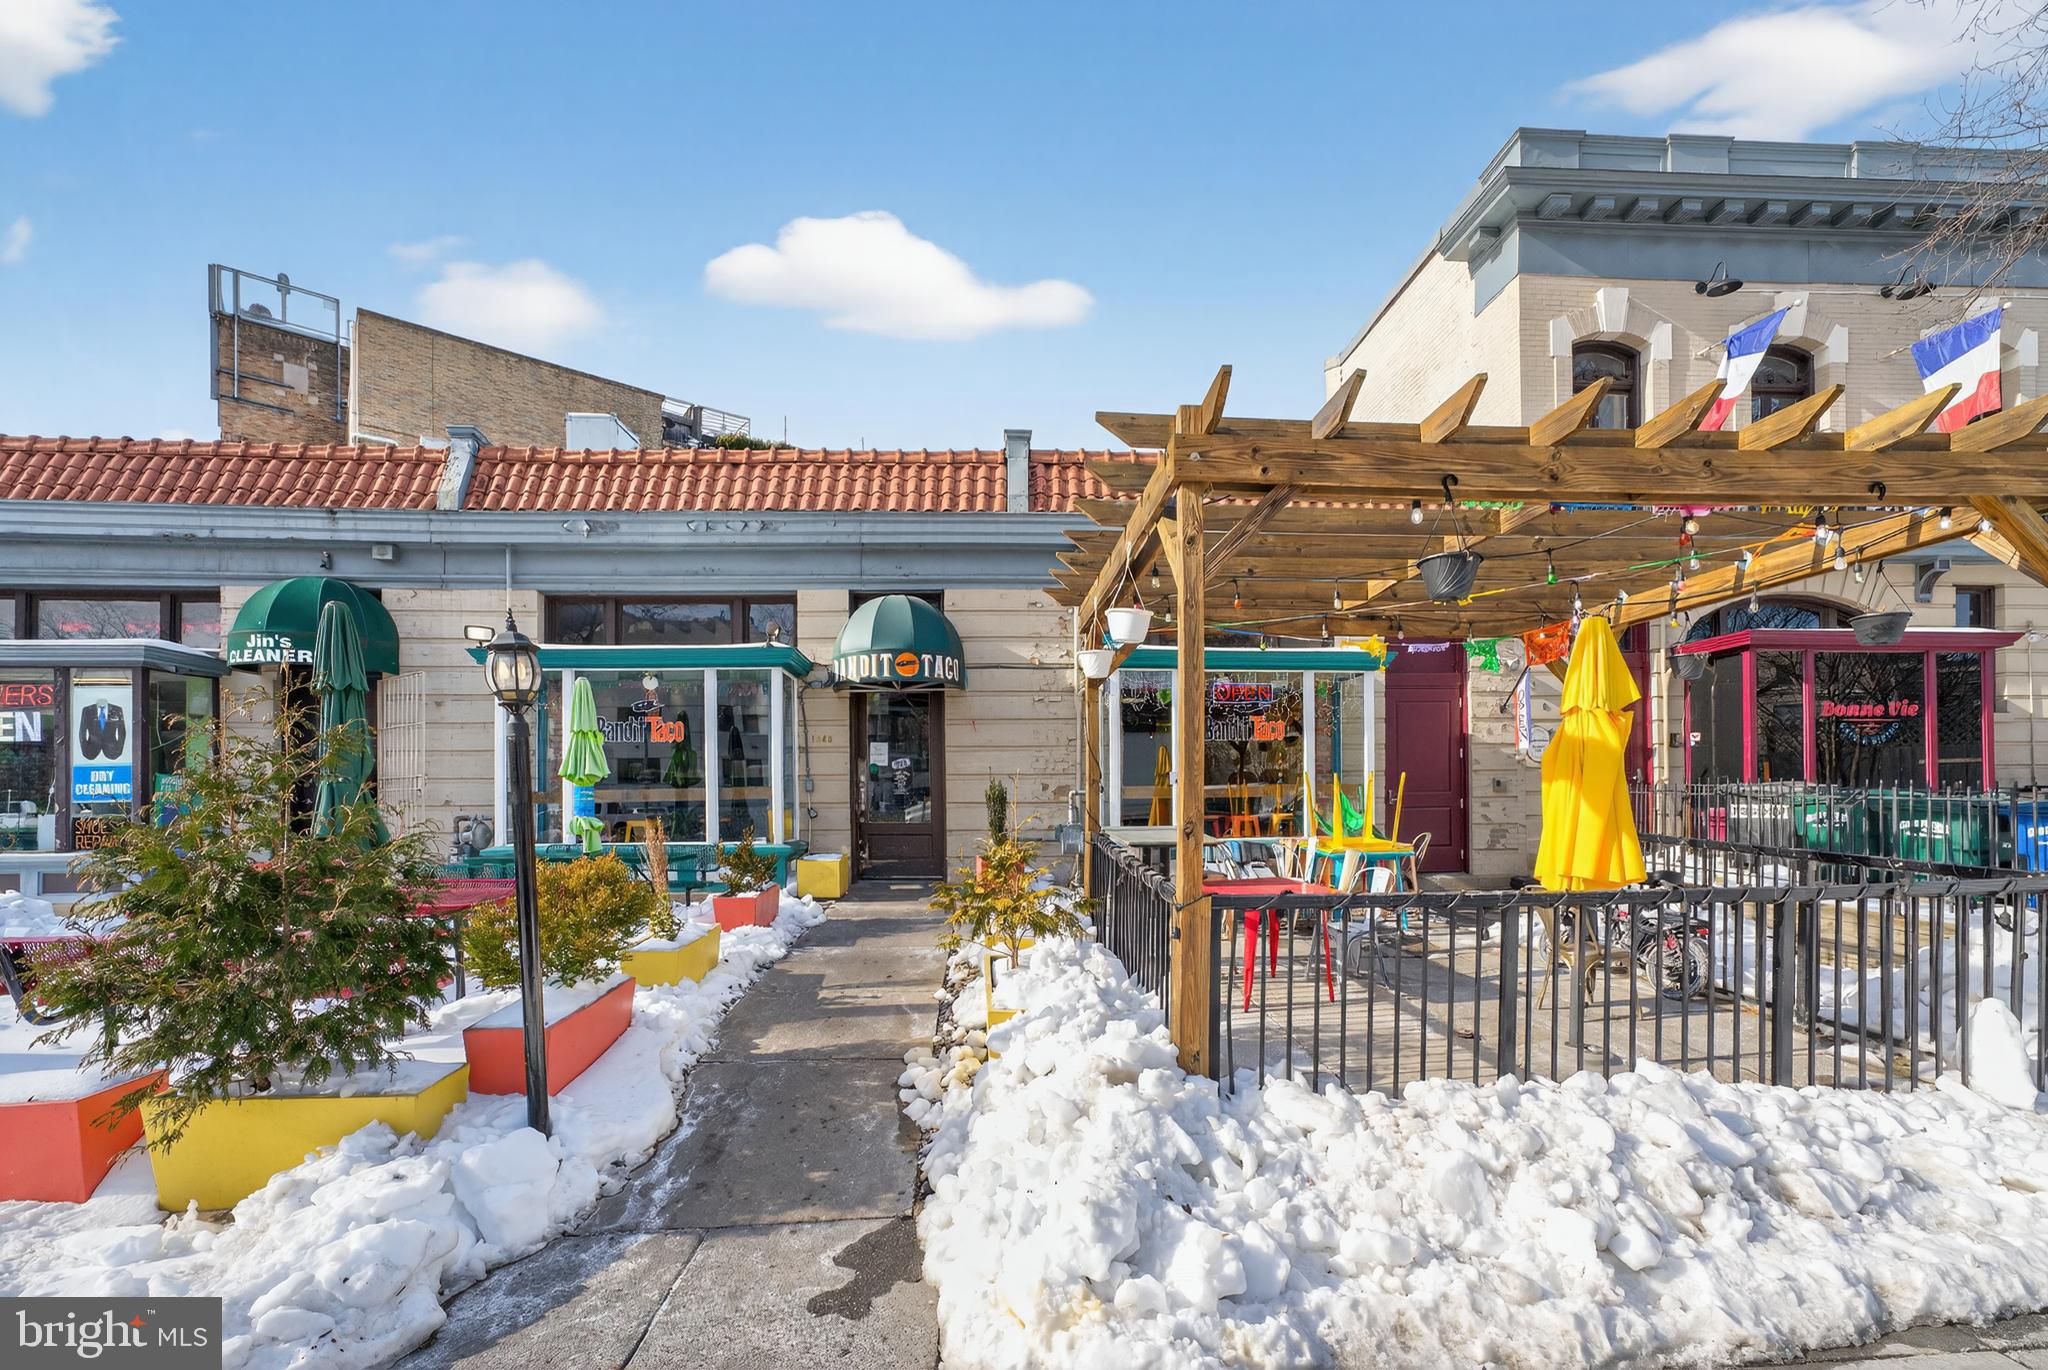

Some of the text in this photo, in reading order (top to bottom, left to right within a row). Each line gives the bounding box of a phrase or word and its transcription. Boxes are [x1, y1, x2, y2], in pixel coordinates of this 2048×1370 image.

[246, 633, 292, 648] Jin's
[921, 653, 960, 682] TACO
[0, 684, 54, 706] ERS
[1214, 684, 1272, 701] OPEN
[1821, 699, 1919, 717] Bonne Vie
[597, 716, 685, 743] Bandit Taco
[1249, 715, 1286, 741] Taco
